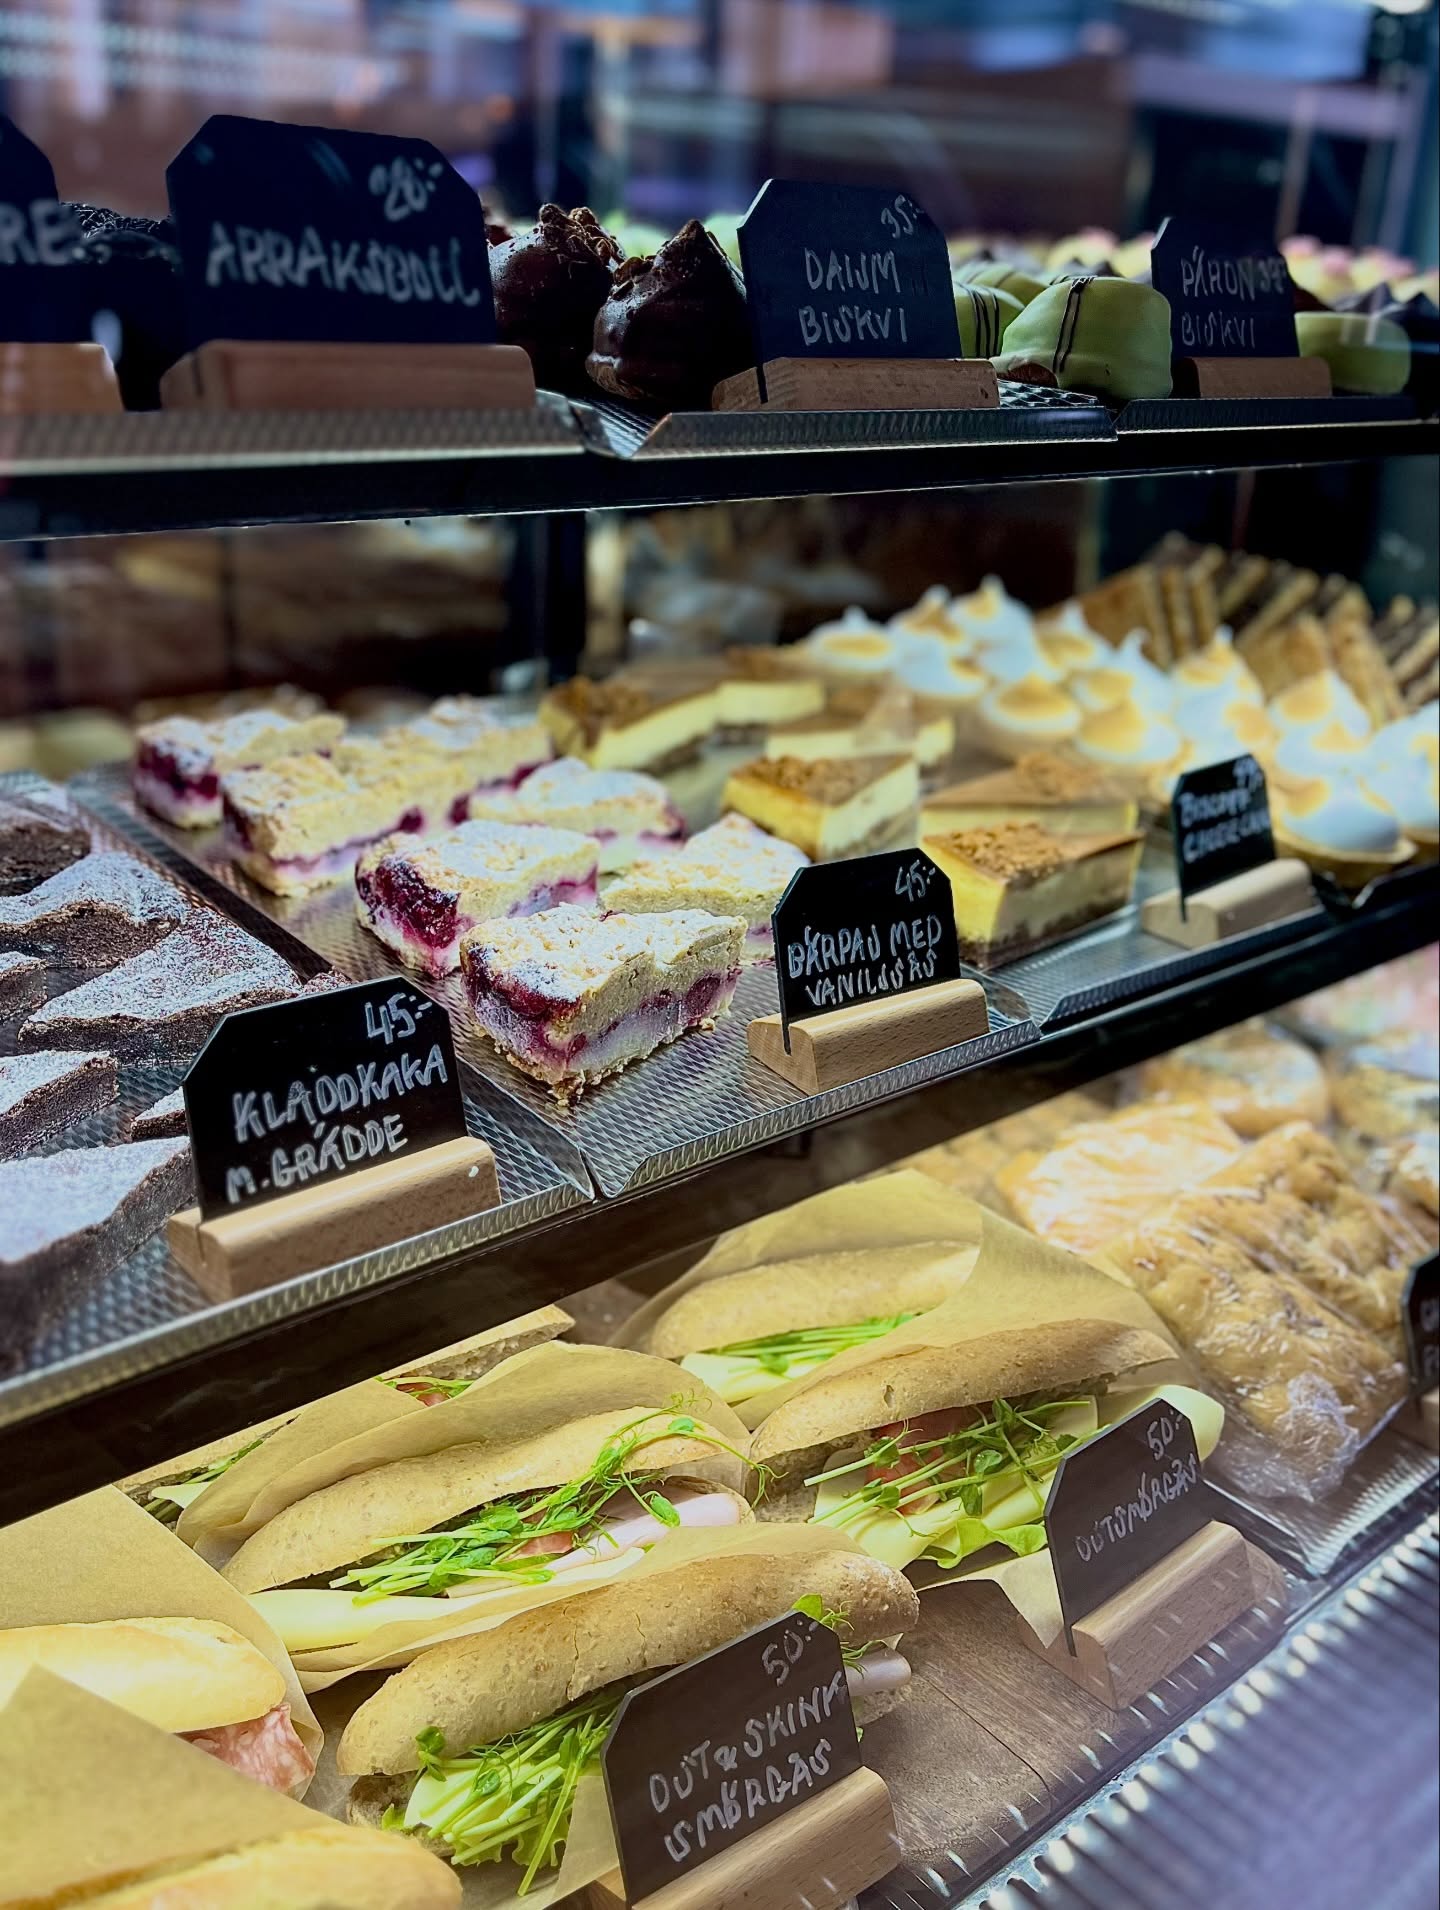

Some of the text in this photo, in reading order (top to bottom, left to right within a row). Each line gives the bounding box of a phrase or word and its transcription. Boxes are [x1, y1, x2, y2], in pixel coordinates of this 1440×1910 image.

[798, 304, 908, 347] BISKVI
[1181, 309, 1256, 349] BISKVI
[895, 859, 936, 902] 45:-
[787, 914, 942, 978] BÄRPAJ MED
[364, 992, 433, 1044] 45:-
[232, 1044, 448, 1143] KLADDKAKA
